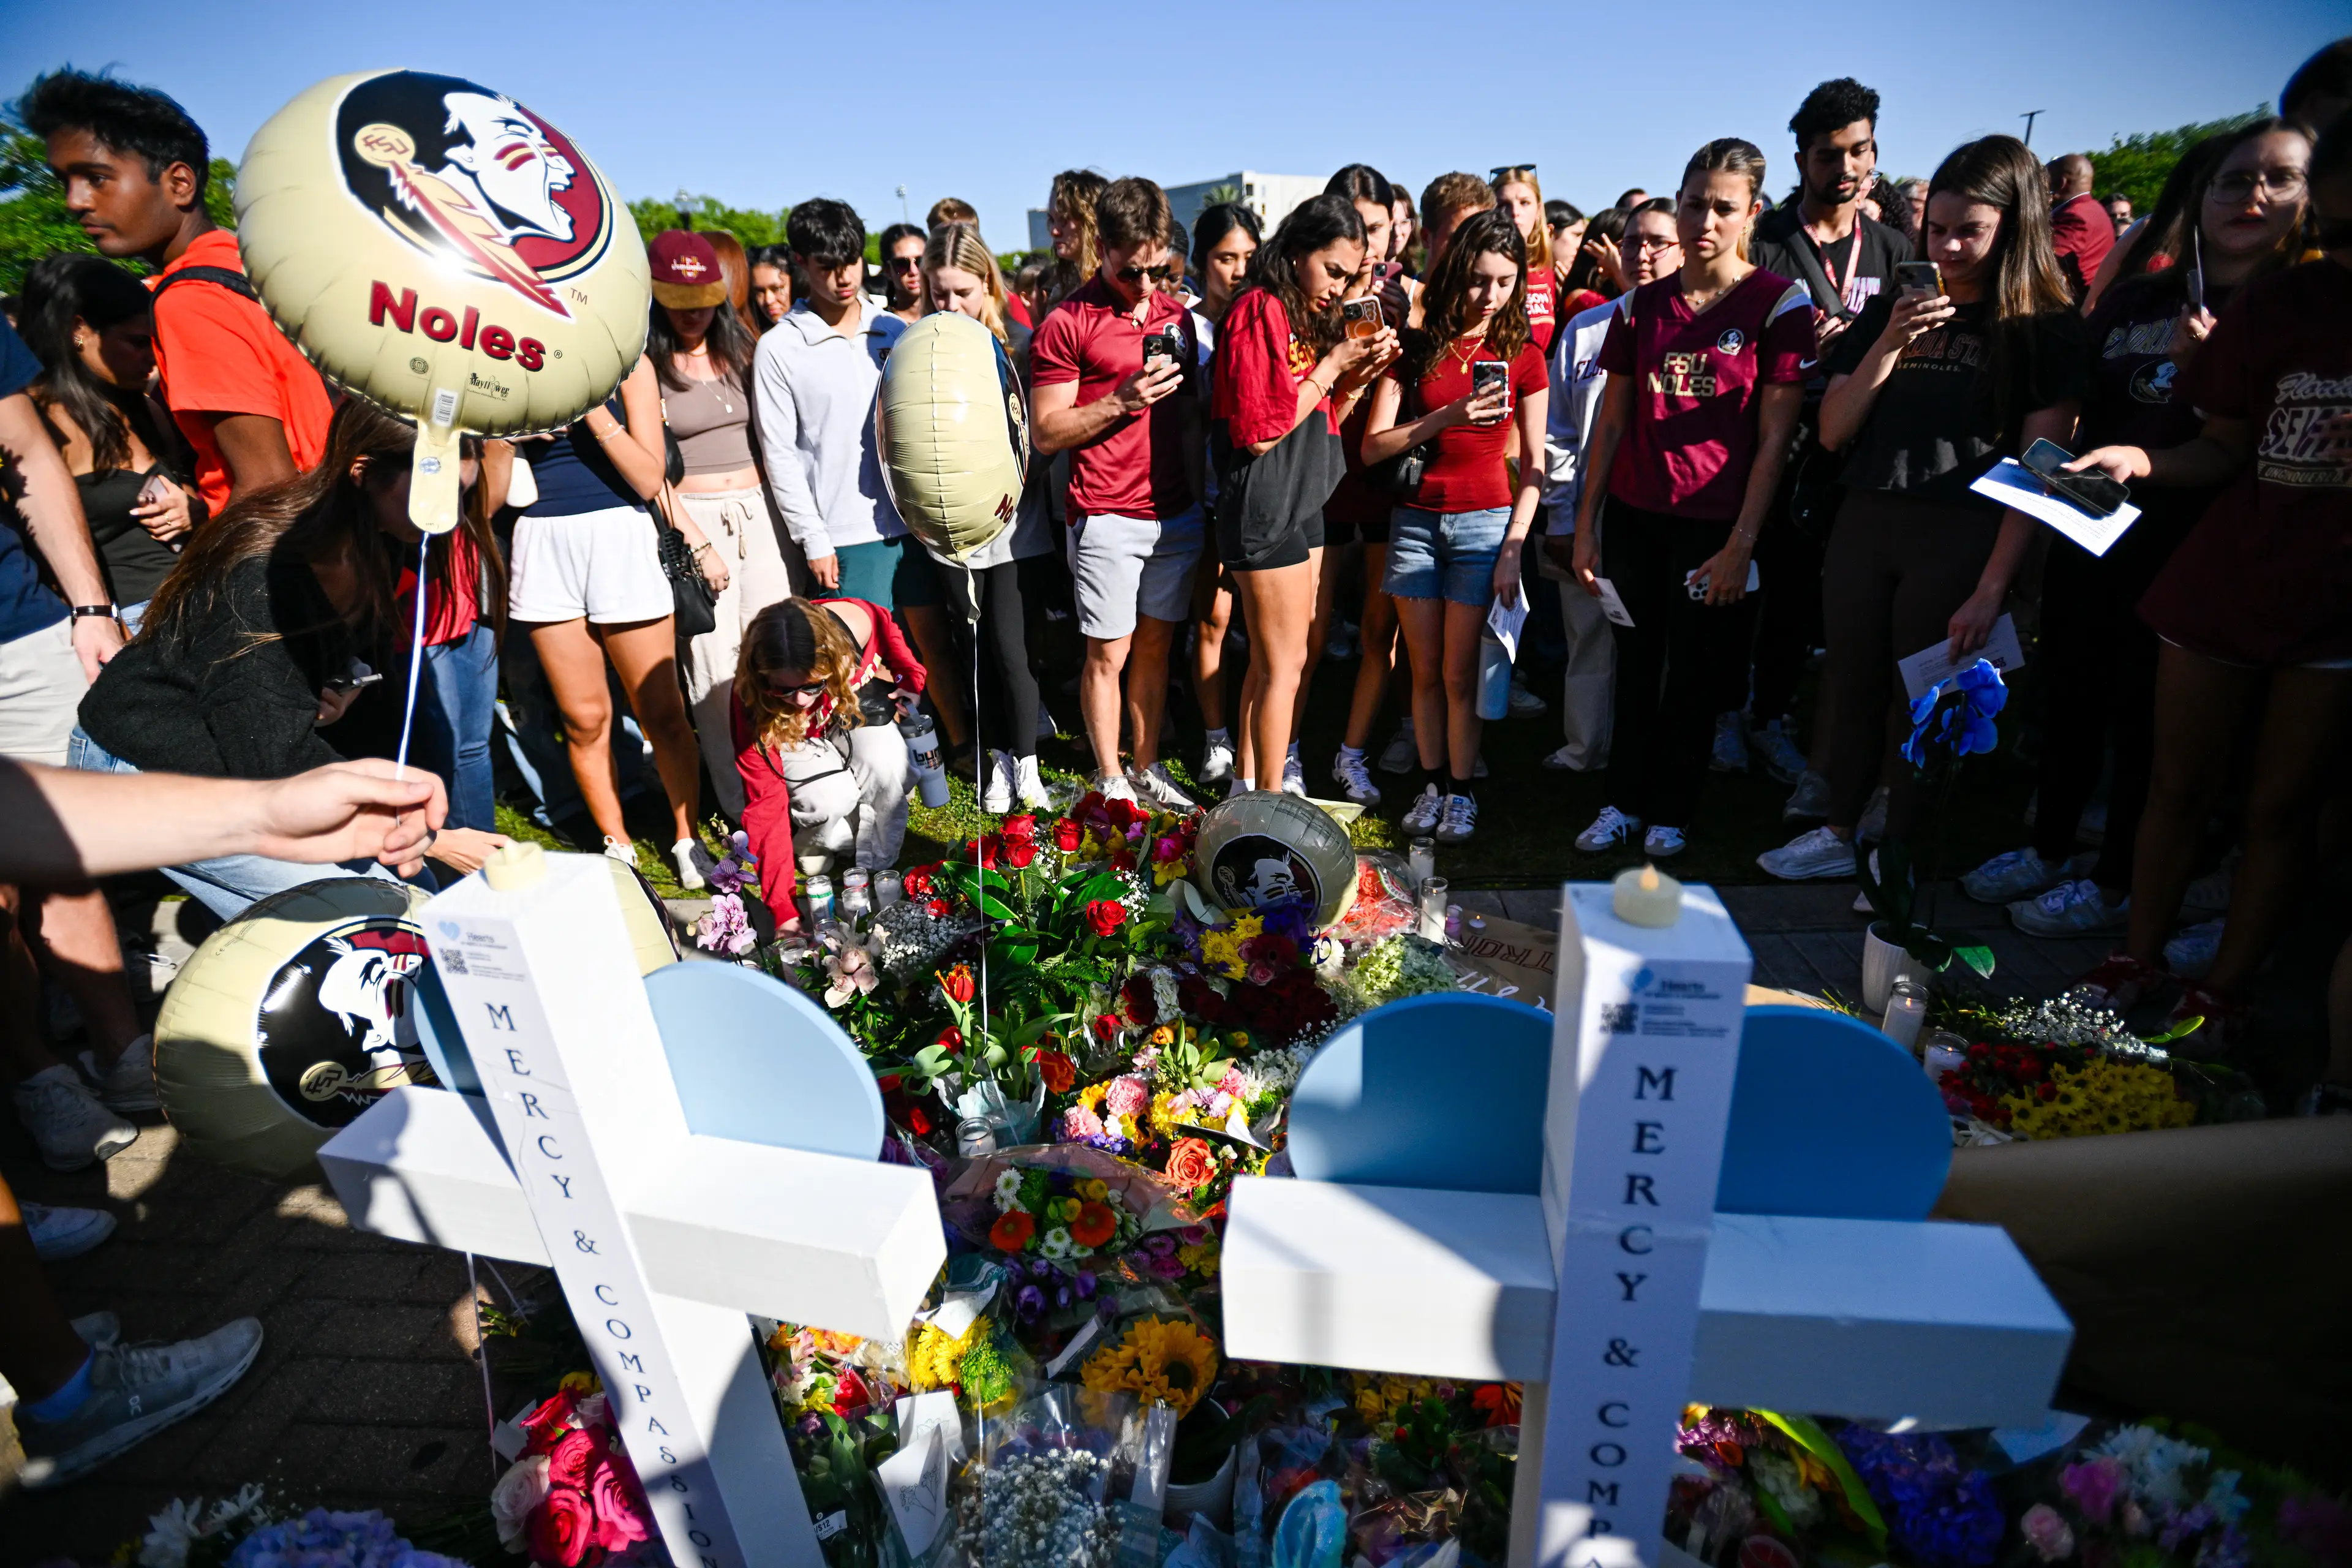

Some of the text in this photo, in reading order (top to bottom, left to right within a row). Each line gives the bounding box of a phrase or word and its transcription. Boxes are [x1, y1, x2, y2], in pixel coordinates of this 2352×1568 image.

[570, 288, 588, 305] TM
[368, 279, 546, 372] Noles
[1664, 352, 1708, 375] FSU
[1647, 371, 1716, 397] NOLES
[1615, 1066, 1679, 1302] MERCY
[483, 1001, 573, 1200] MERCY
[573, 1229, 601, 1256] &
[594, 1283, 718, 1568] COMPASSION
[1603, 1338, 1642, 1368] &
[813, 1519, 831, 1534] /$12
